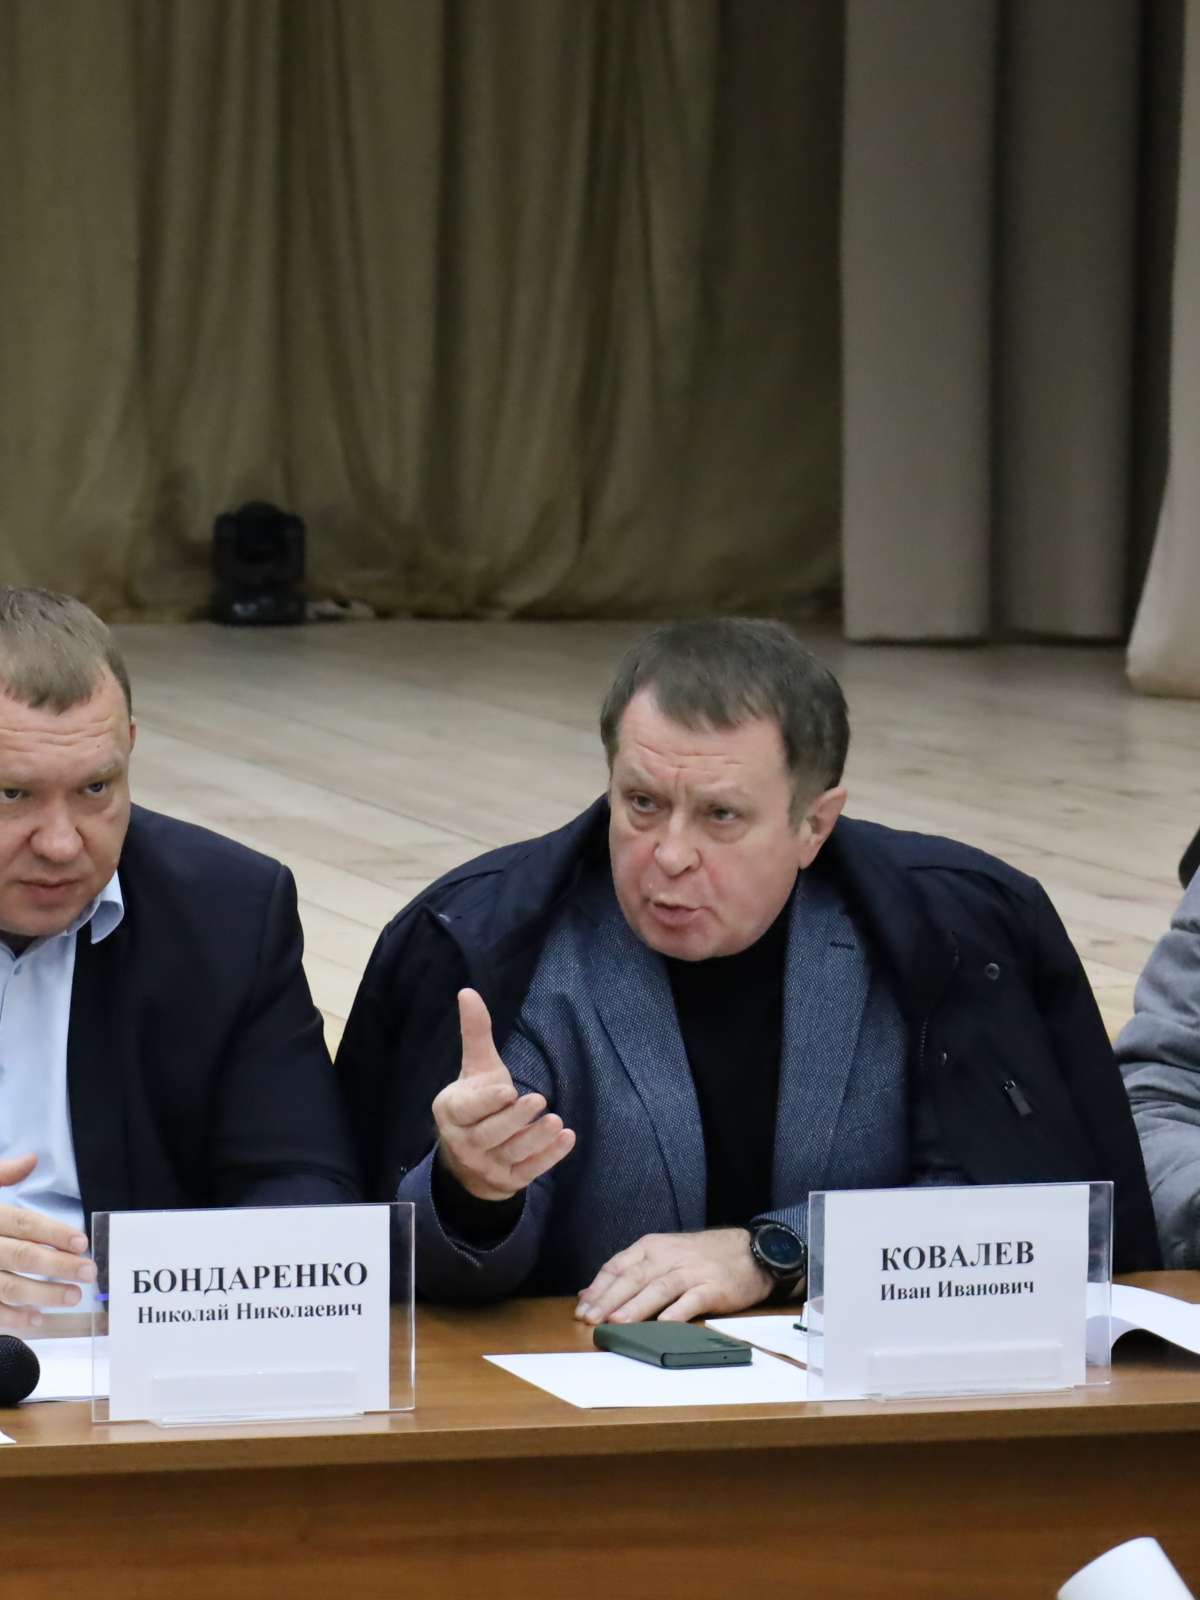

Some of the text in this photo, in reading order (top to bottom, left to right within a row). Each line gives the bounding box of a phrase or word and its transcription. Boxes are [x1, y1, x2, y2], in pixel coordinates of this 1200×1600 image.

[881, 1240, 1035, 1272] КОВАЛЕВ
[132, 1261, 368, 1296] БОНДАРЕНКО
[880, 1280, 1034, 1301] Иван Иванович
[138, 1302, 362, 1324] Николай Николаевич
